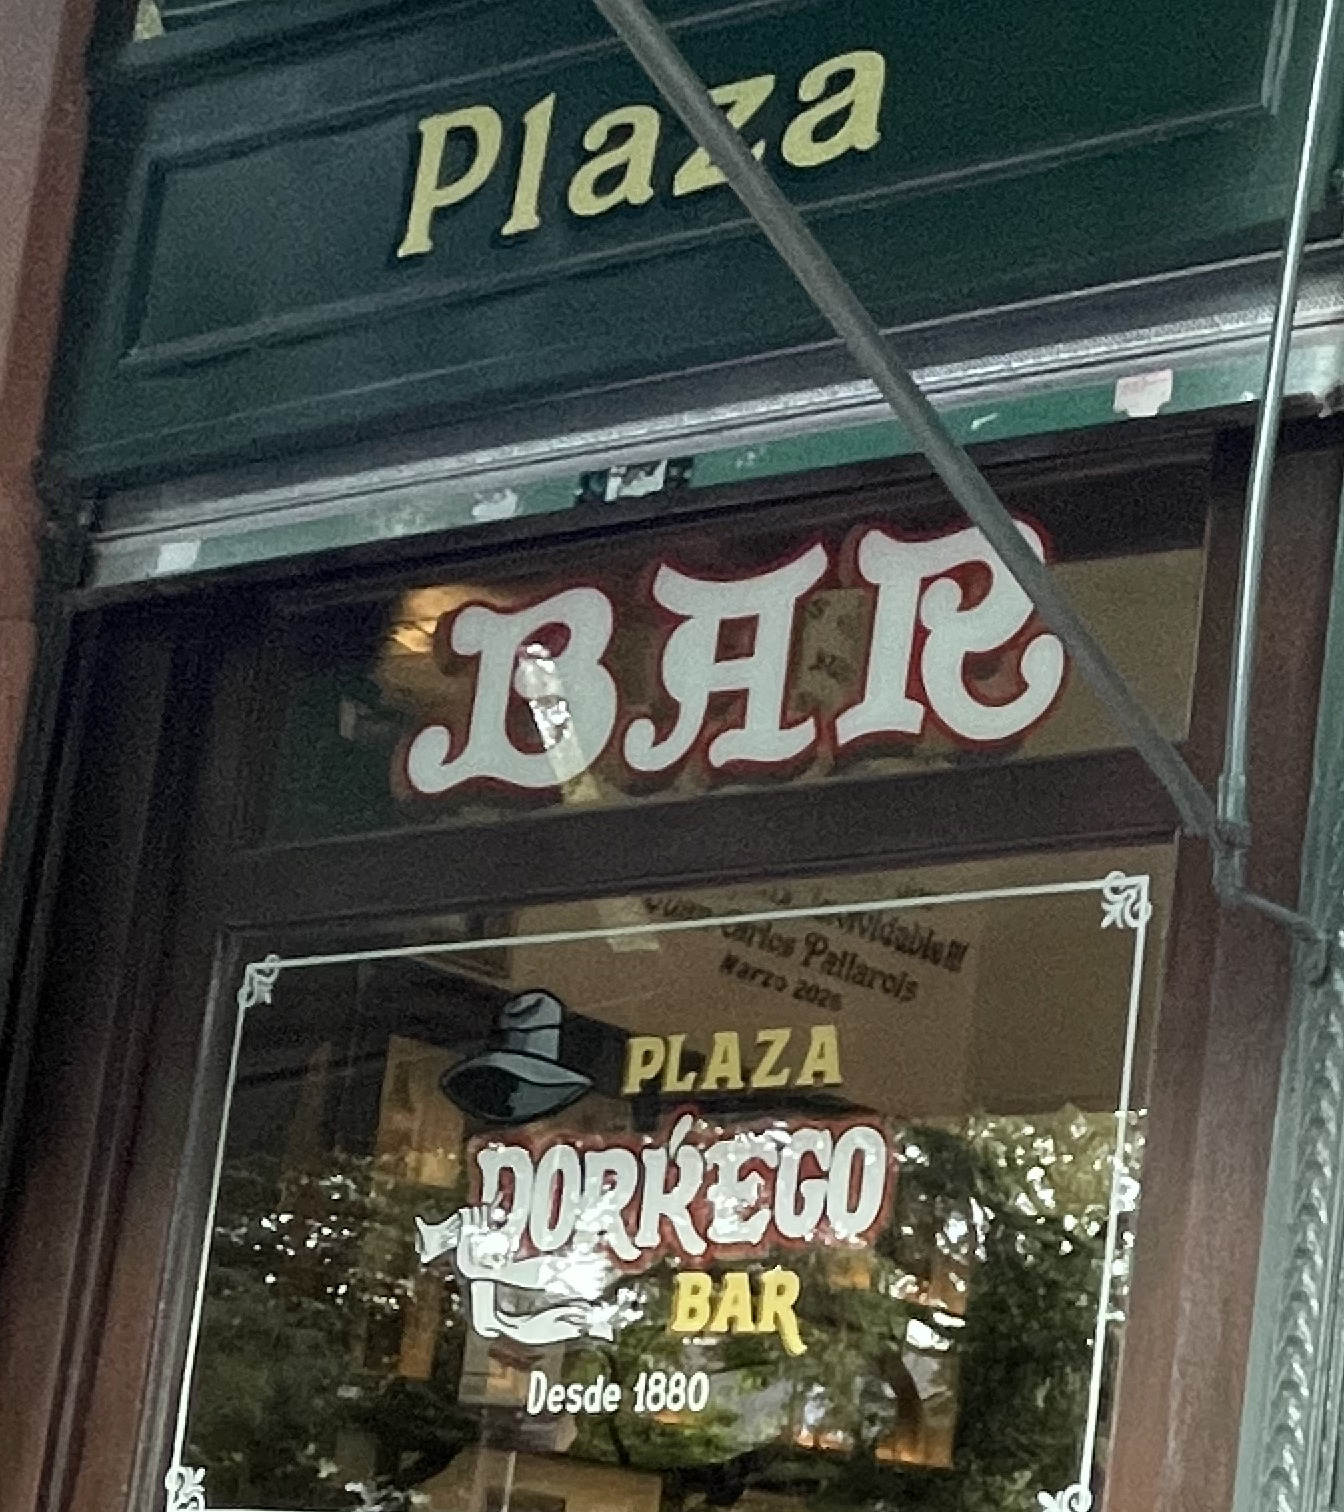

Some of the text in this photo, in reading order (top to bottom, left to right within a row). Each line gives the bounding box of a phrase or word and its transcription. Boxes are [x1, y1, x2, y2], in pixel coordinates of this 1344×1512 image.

[396, 49, 888, 259] Plaza
[403, 518, 1068, 797] BAR
[621, 1023, 842, 1096] PLAZA
[472, 1108, 894, 1267] DORREGO
[671, 1270, 808, 1356] BAR
[526, 1369, 710, 1416] Desde 1880
